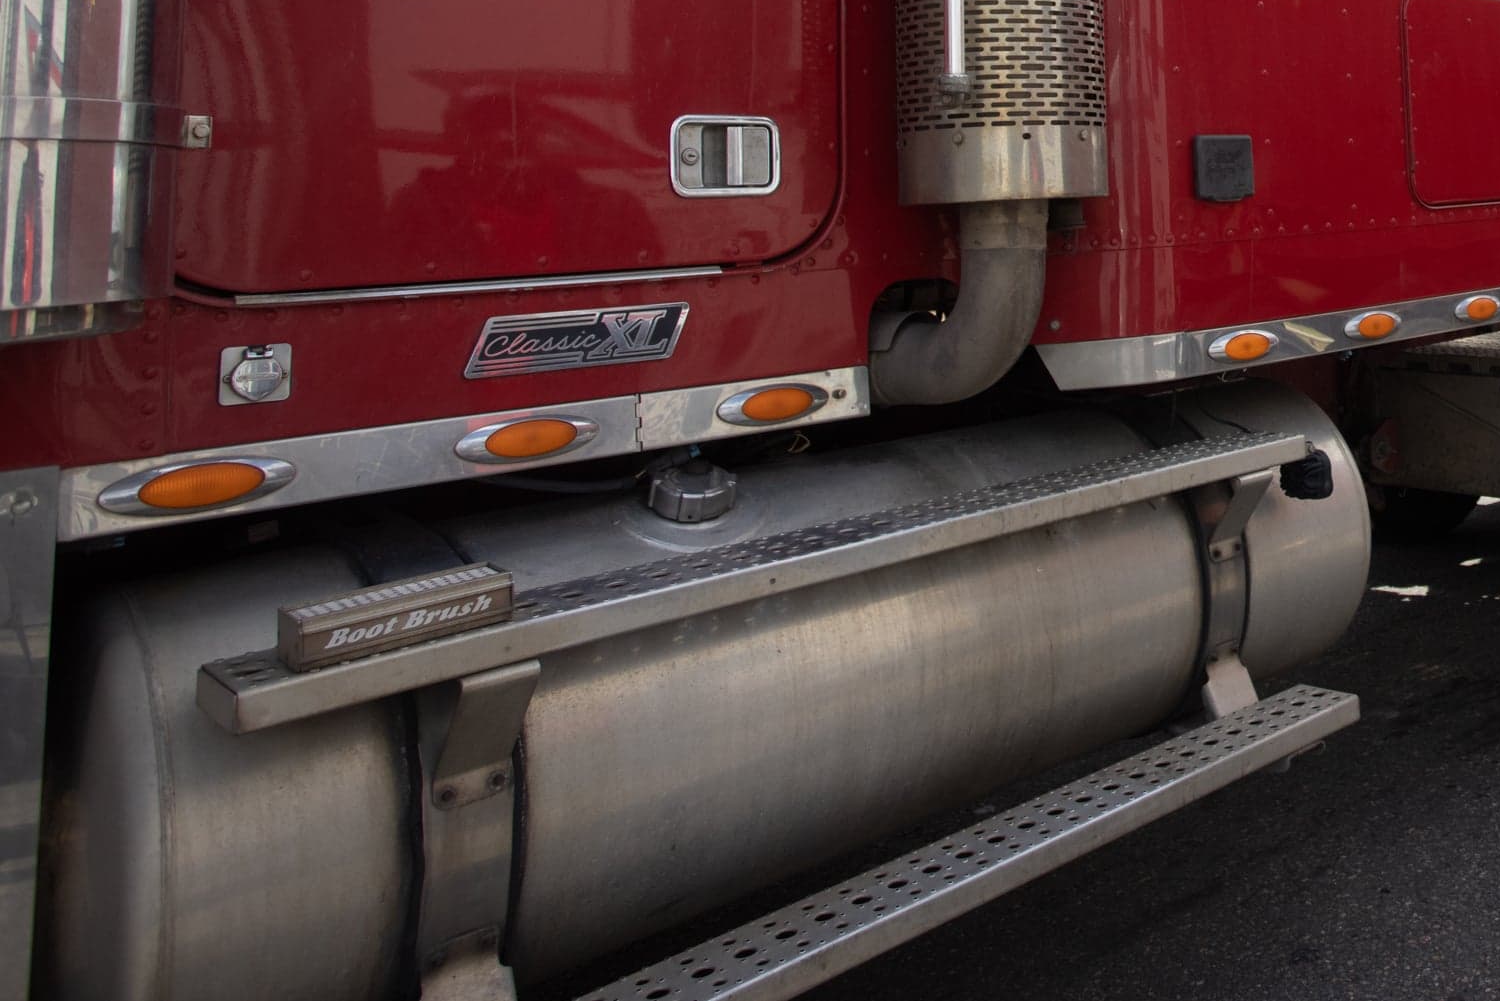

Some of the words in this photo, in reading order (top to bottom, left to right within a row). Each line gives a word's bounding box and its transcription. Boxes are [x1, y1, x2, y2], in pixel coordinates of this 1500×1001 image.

[484, 330, 602, 358] Classic
[586, 309, 668, 359] XL
[324, 615, 399, 650] Boot
[402, 593, 493, 631] Brush
